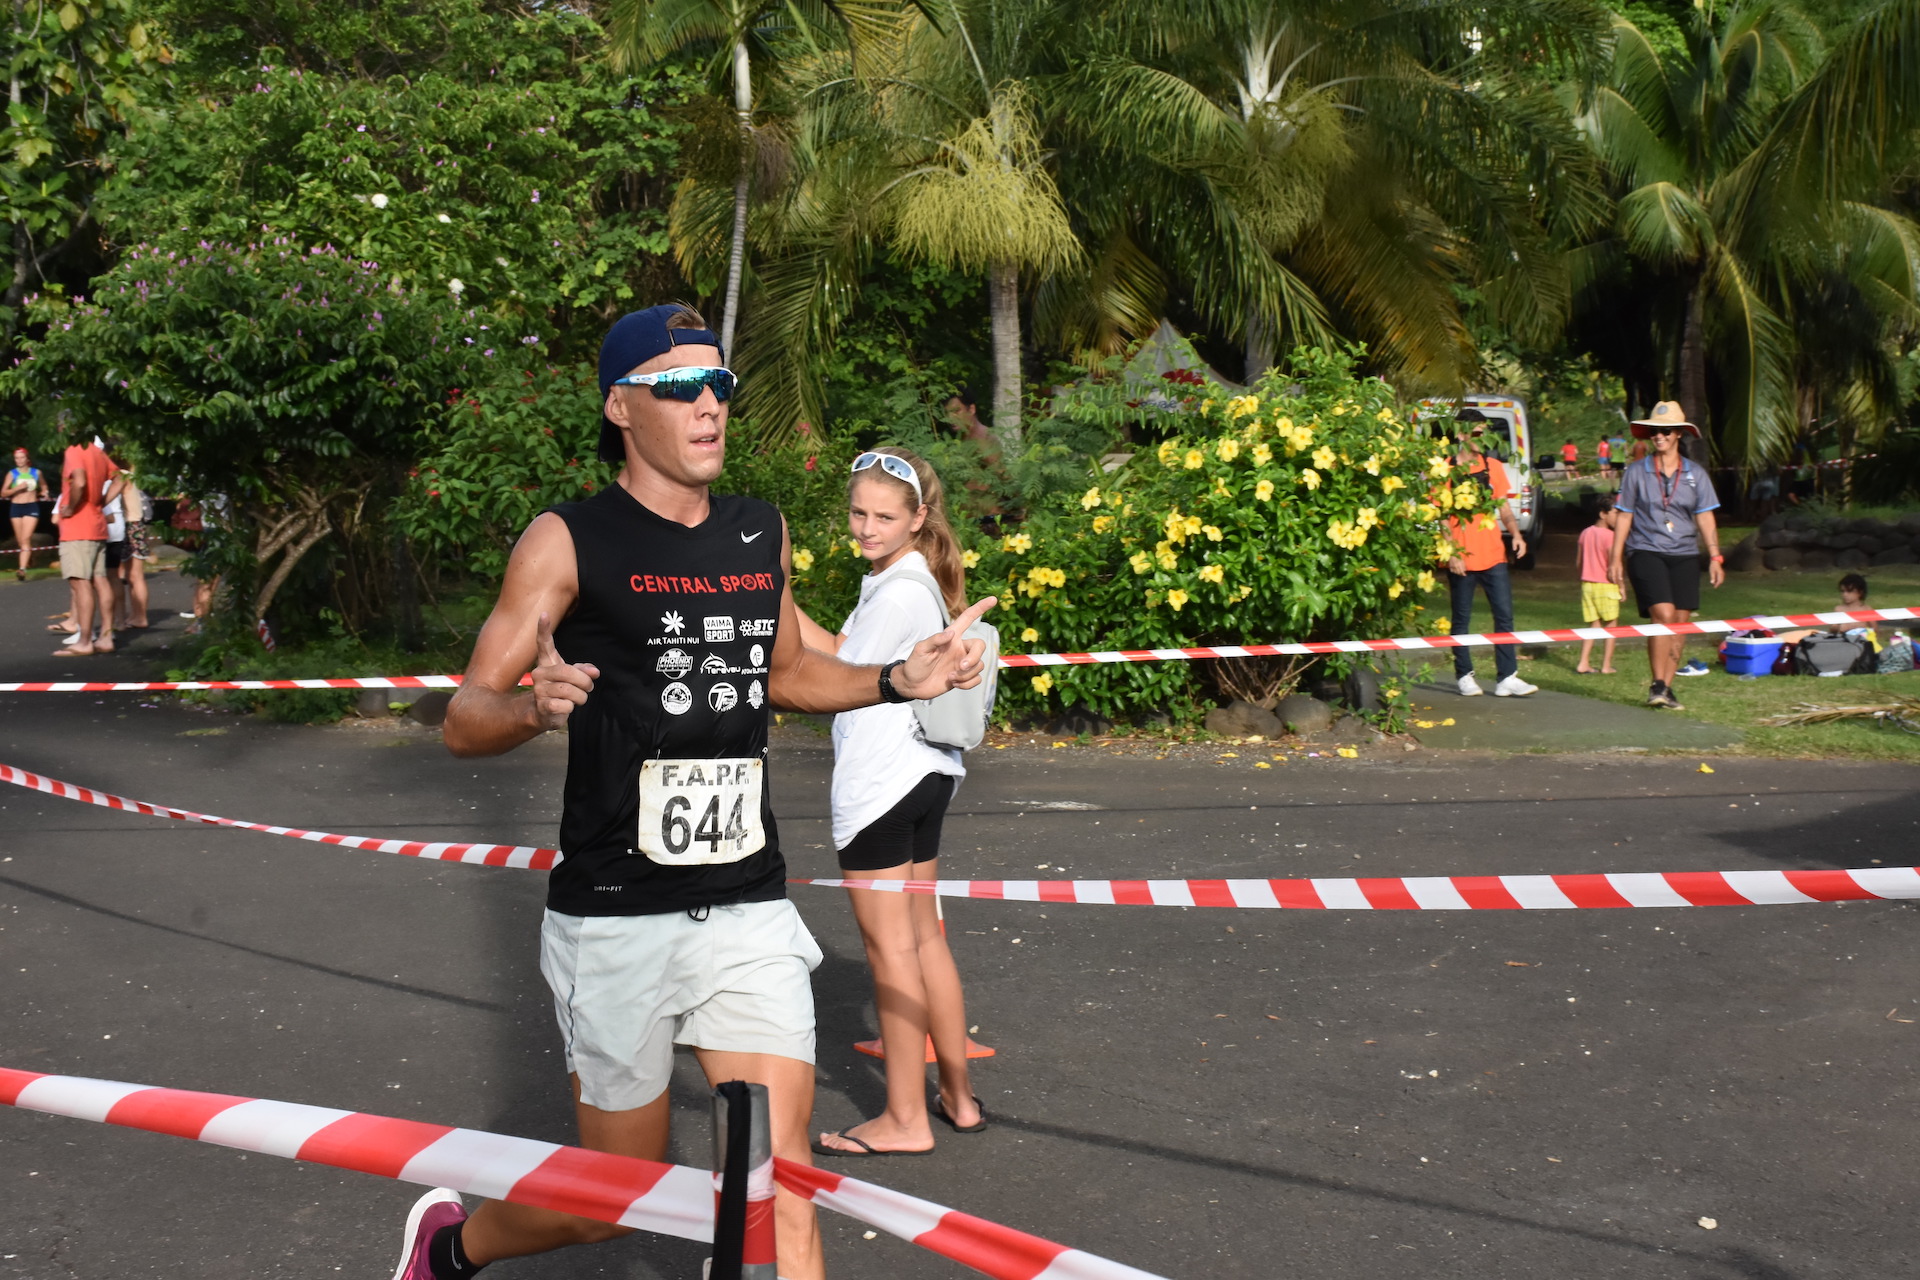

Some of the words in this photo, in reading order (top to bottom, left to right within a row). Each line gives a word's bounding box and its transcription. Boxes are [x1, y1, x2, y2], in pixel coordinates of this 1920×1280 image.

[629, 574, 717, 594] CENTRAL
[719, 573, 775, 592] SPORT
[705, 619, 732, 628] VAIMA
[753, 619, 775, 631] STC
[706, 629, 734, 640] SPORT
[647, 638, 662, 646] AIR
[662, 637, 686, 645] TAHITI
[686, 637, 700, 645] NUI
[659, 657, 692, 665] PHOENIX
[661, 793, 748, 855] 644
